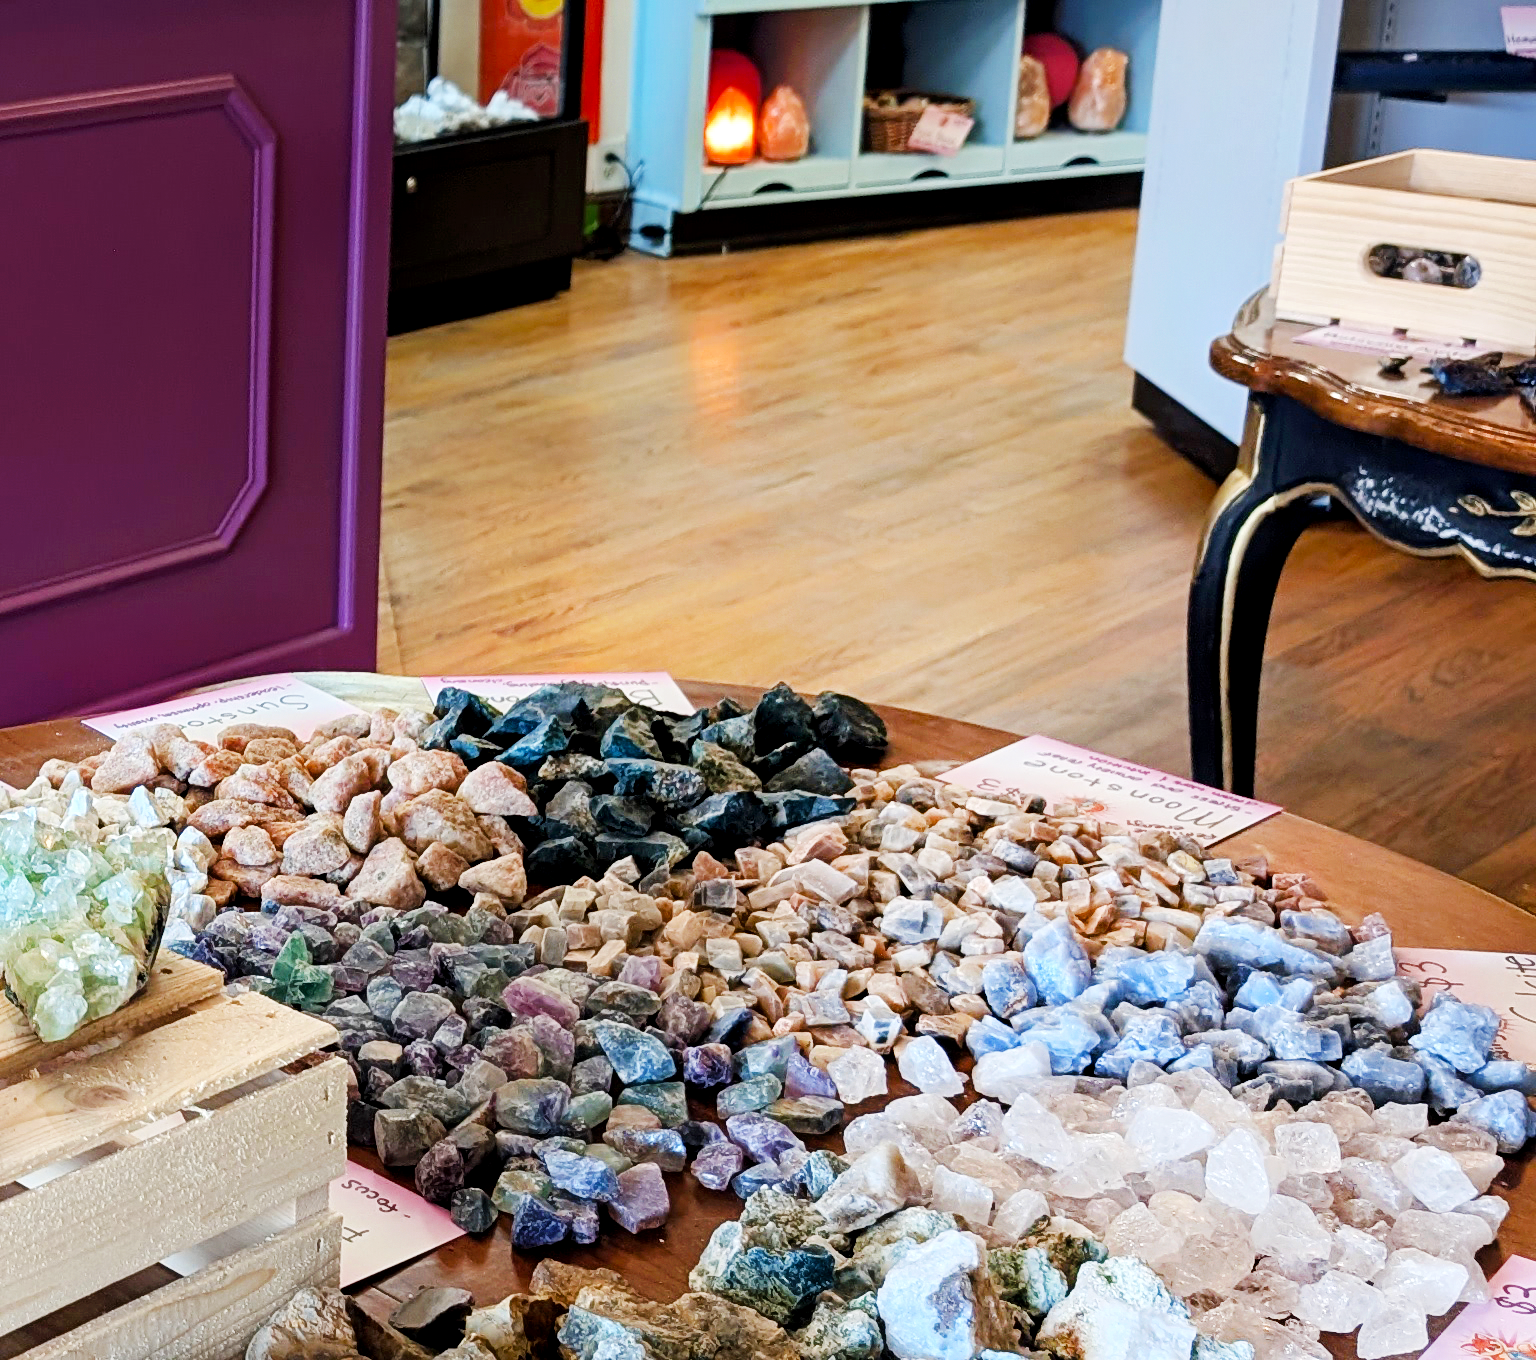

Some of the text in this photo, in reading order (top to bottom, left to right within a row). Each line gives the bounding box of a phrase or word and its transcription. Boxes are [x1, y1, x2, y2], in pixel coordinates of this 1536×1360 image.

[976, 778, 1024, 801] $3
[1023, 759, 1233, 829] Moonstone
[1398, 961, 1465, 992] $3
